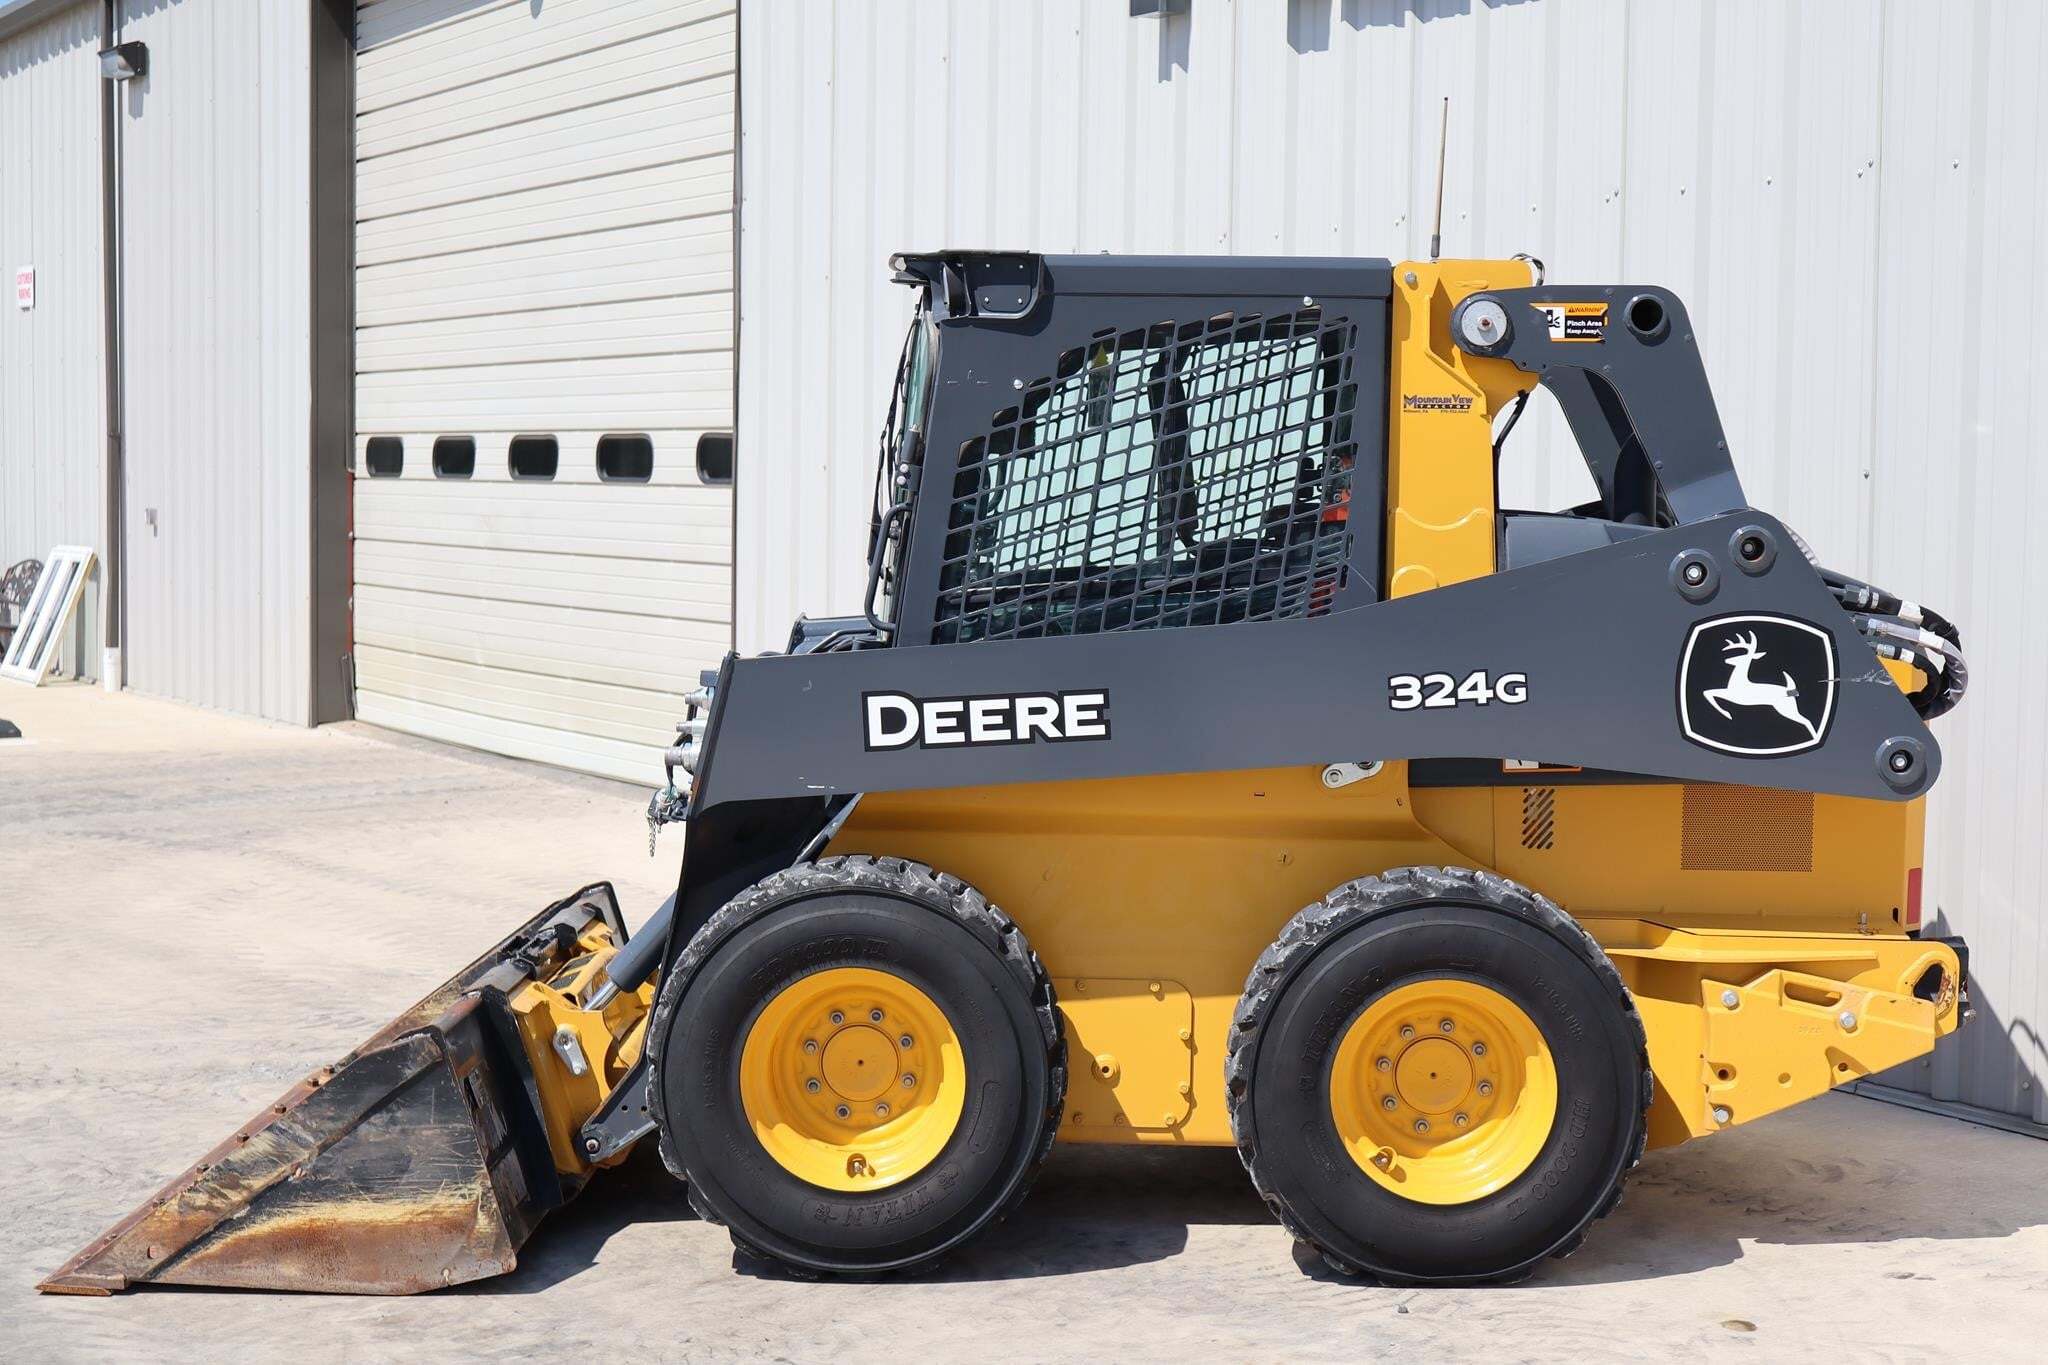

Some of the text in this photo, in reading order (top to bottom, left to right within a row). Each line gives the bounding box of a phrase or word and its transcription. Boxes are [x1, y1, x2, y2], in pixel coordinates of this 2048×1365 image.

[1403, 394, 1452, 409] MOUNTAIN
[1389, 670, 1528, 710] 324G
[866, 692, 1107, 748] DEERE
